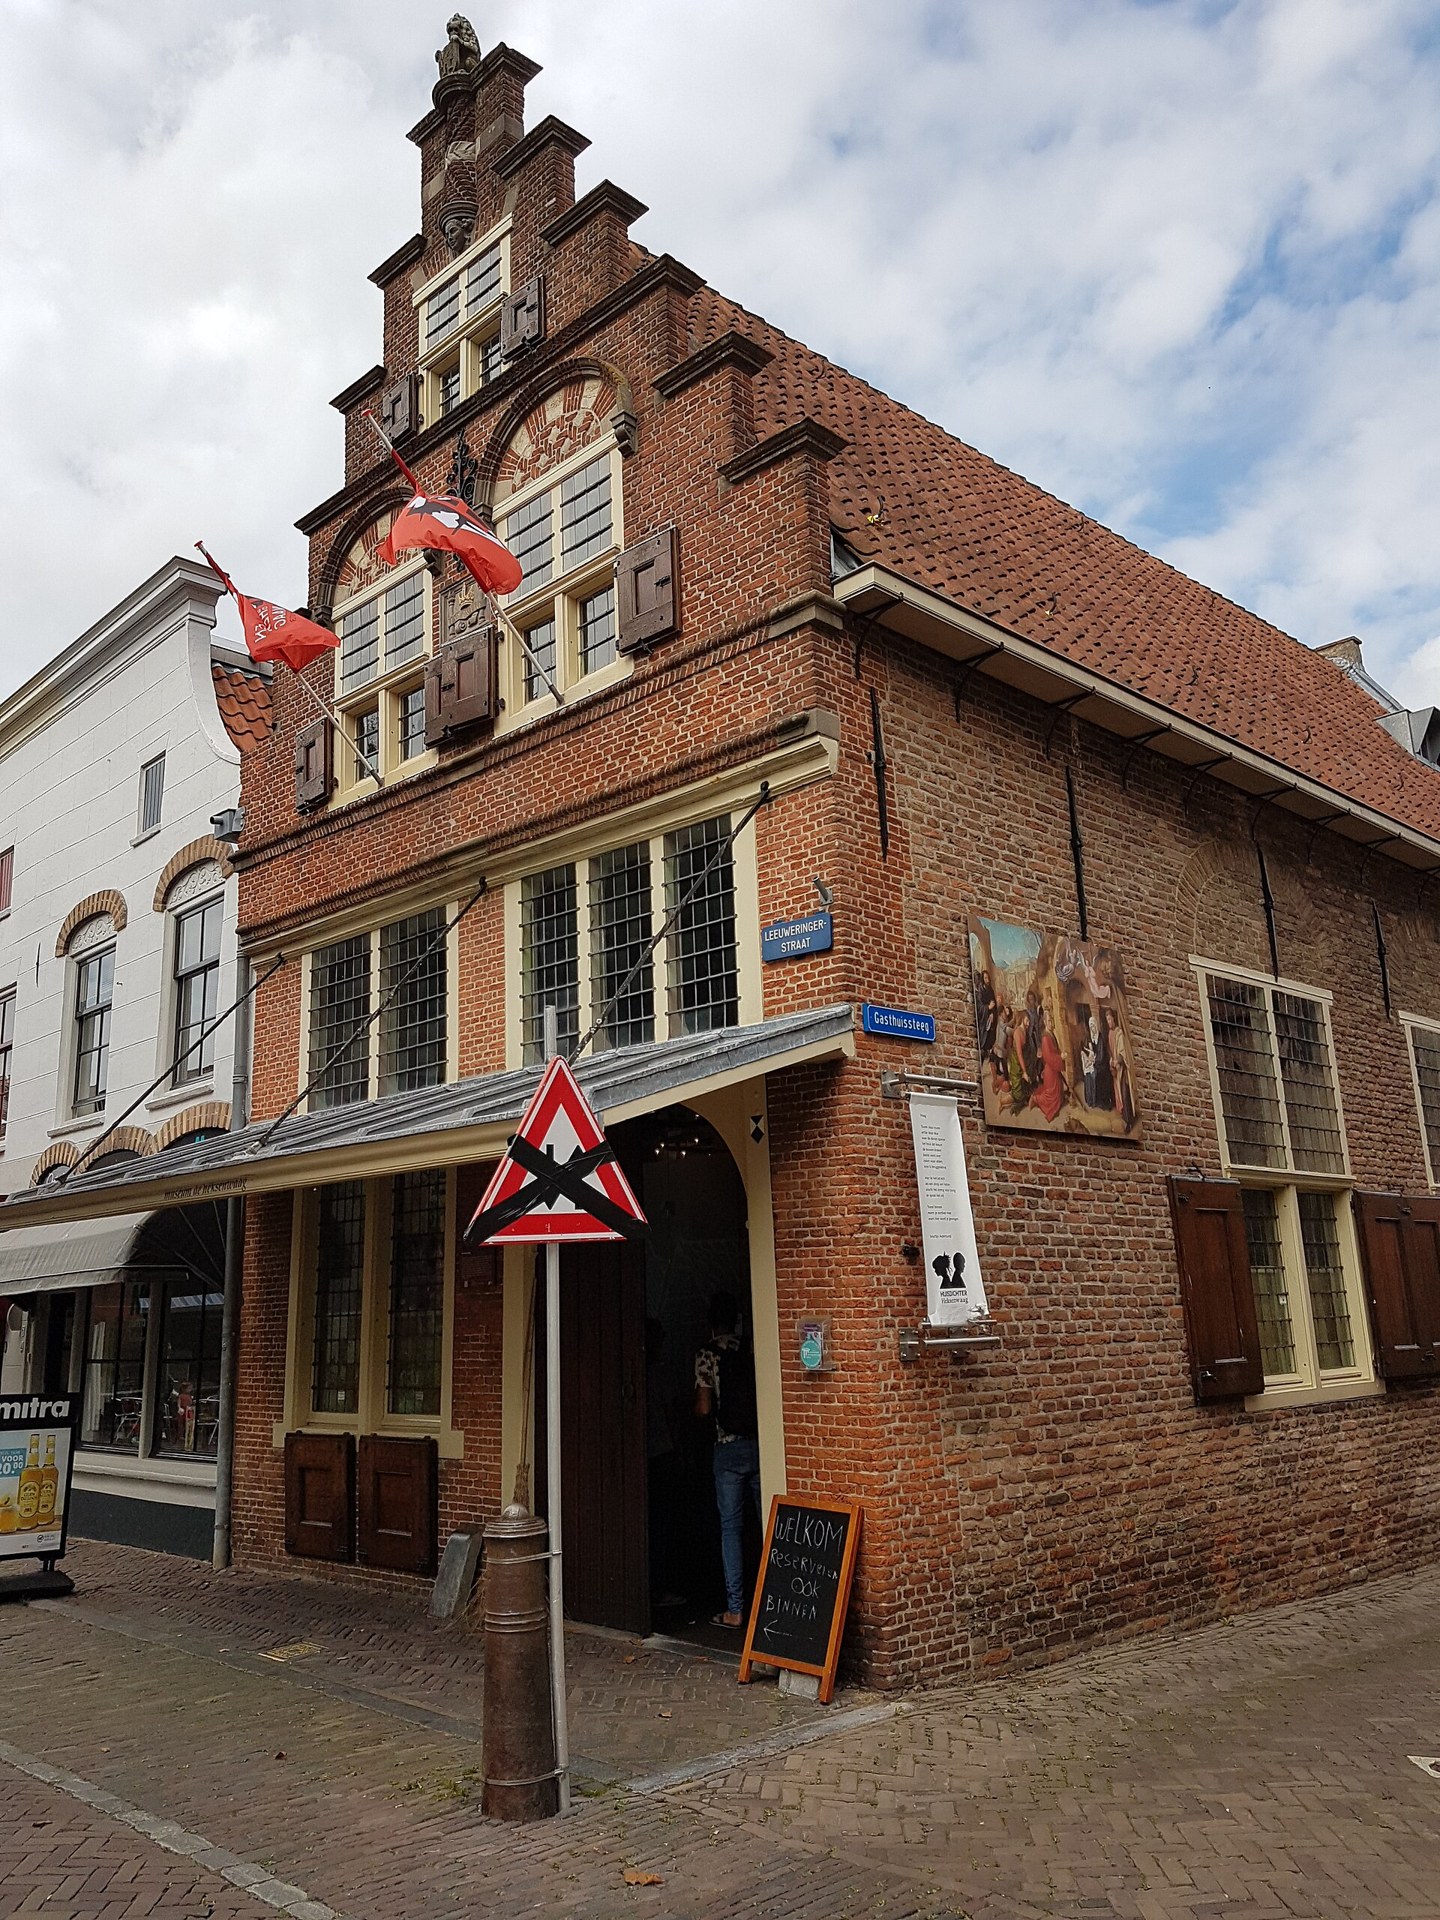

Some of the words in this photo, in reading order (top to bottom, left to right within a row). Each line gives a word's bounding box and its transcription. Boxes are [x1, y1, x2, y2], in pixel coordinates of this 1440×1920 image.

[764, 919, 827, 942] LEEUWERINGER-
[781, 937, 811, 953] STRAAT
[874, 1011, 930, 1034] Gasthuissteeg
[0, 1397, 70, 1419] mitra
[775, 1511, 843, 1554] WELKOM
